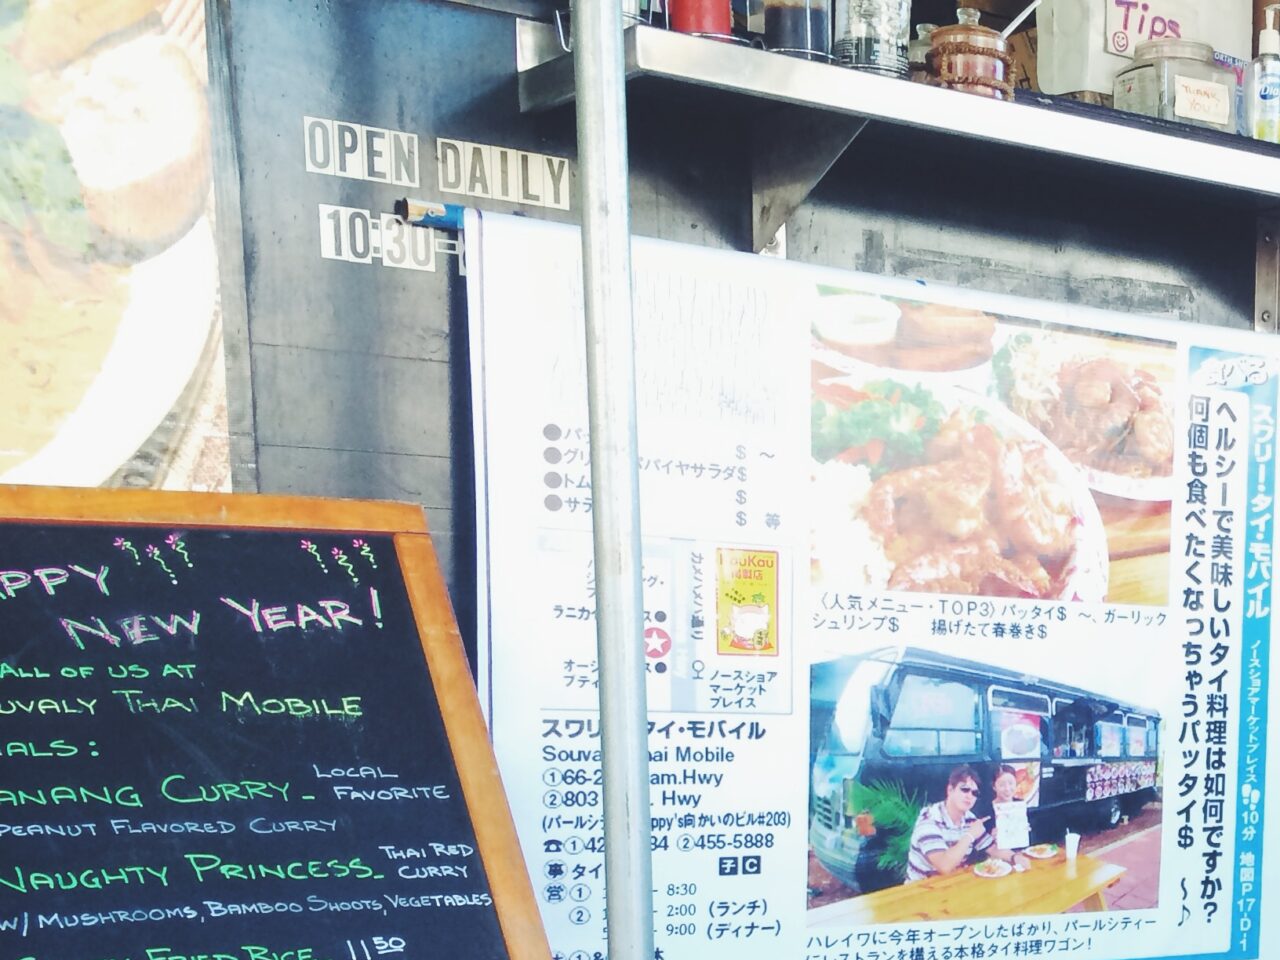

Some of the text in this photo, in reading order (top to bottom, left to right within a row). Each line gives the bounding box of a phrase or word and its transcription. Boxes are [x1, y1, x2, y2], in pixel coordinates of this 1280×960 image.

[1115, 0, 1181, 39] Tips
[307, 120, 566, 205] OPEN DAILY
[0, 563, 109, 600] PPY
[58, 586, 384, 650] NEW YEAR!
[0, 662, 197, 680] ALL OF US AT
[112, 689, 199, 714] THAI
[221, 690, 364, 717] MOBILE
[0, 738, 101, 757] ALS:
[675, 746, 735, 763] Mobile
[313, 763, 400, 781] LOCAL
[161, 774, 291, 804] CURRY
[333, 784, 451, 802] FAVORITE
[662, 790, 701, 808] Hwy
[0, 816, 338, 838] PEANUT FLAVORED CURRY
[379, 841, 474, 860] THAI RED
[0, 860, 169, 894] NAUGHTY
[398, 862, 469, 880] CURRY
[666, 883, 697, 896] 8:30
[203, 899, 303, 919] BAMBOO
[384, 891, 493, 910] VEGETABLES
[666, 904, 697, 917] 2:00
[666, 923, 697, 936] 9:00
